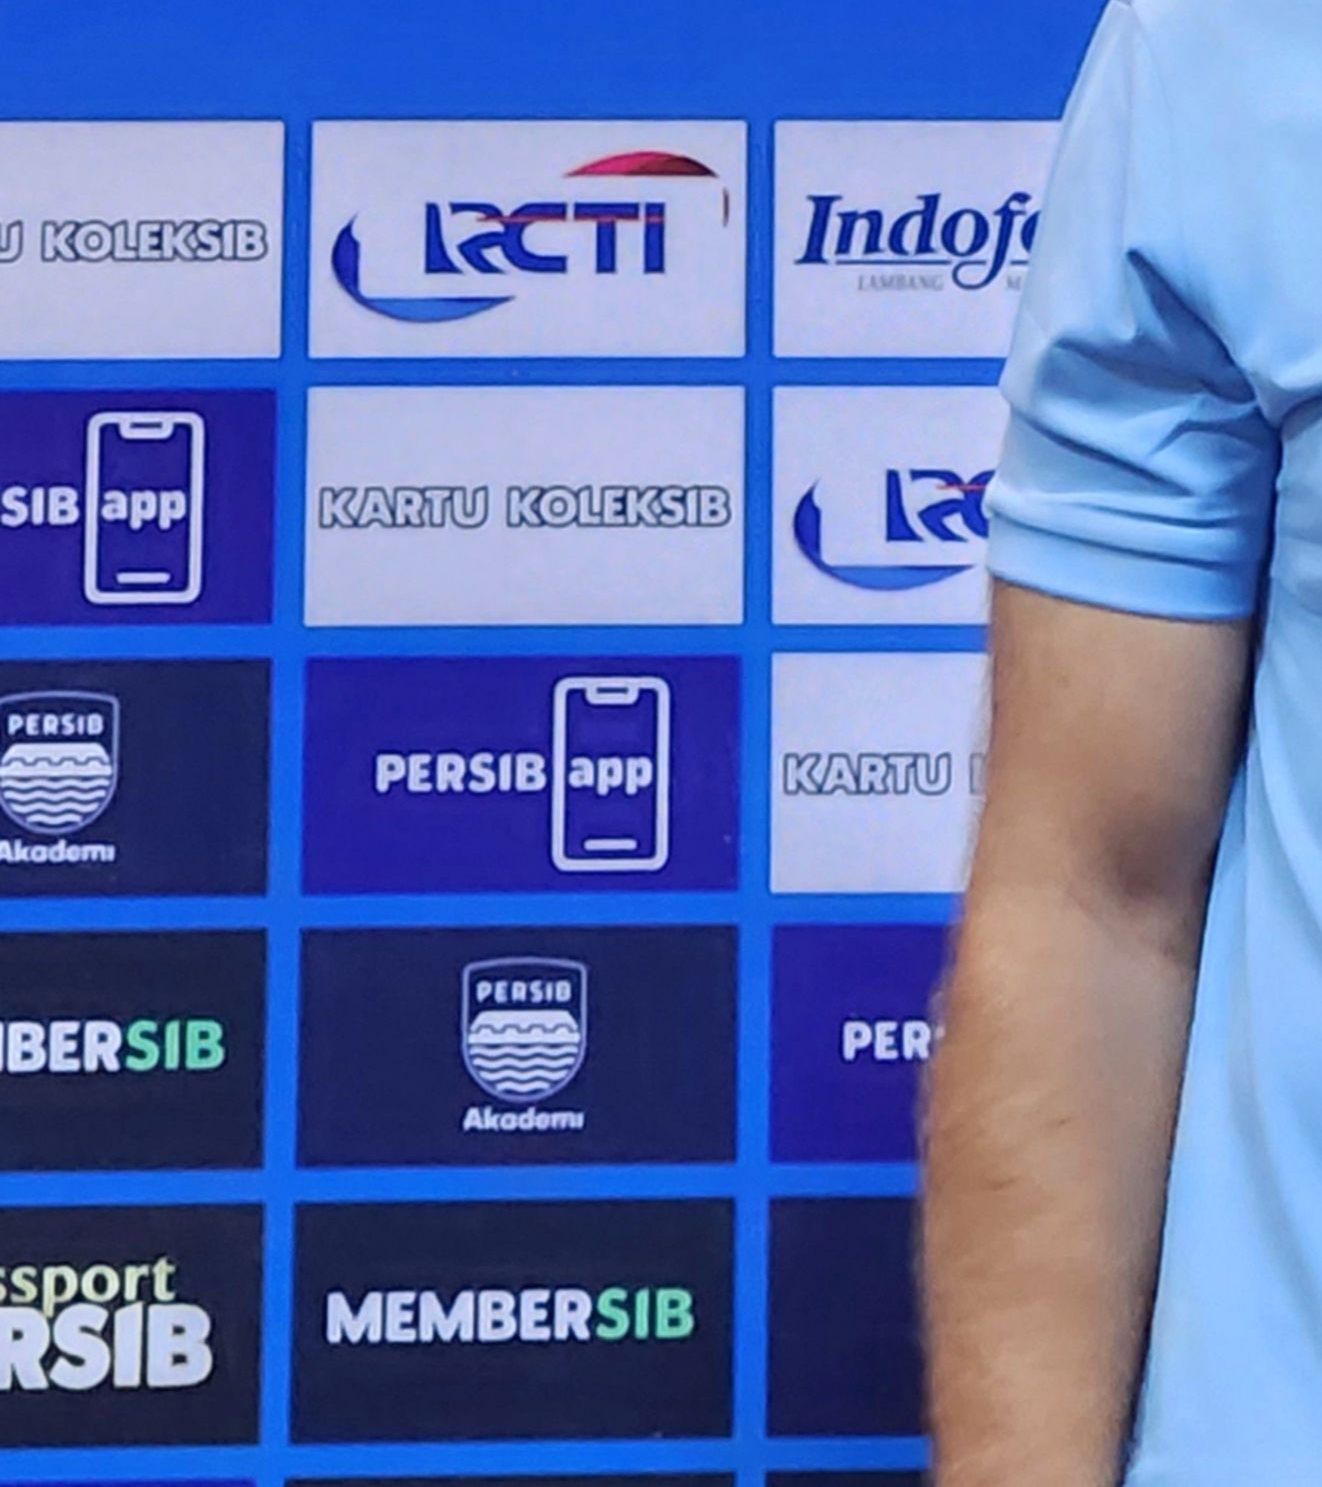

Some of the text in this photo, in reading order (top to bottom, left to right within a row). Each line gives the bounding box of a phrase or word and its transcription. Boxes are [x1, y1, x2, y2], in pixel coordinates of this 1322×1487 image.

[41, 219, 268, 263] KOLEKSIB
[425, 202, 666, 274] RCTI
[101, 489, 187, 531] app
[318, 484, 732, 529] KARTU KOLEKSIB
[7, 713, 104, 736] PERSIB
[375, 751, 654, 796] PERSIB app
[783, 752, 952, 796] KARTU
[475, 979, 573, 1004] PERSIB
[325, 1286, 695, 1344] MEMBERSIB
